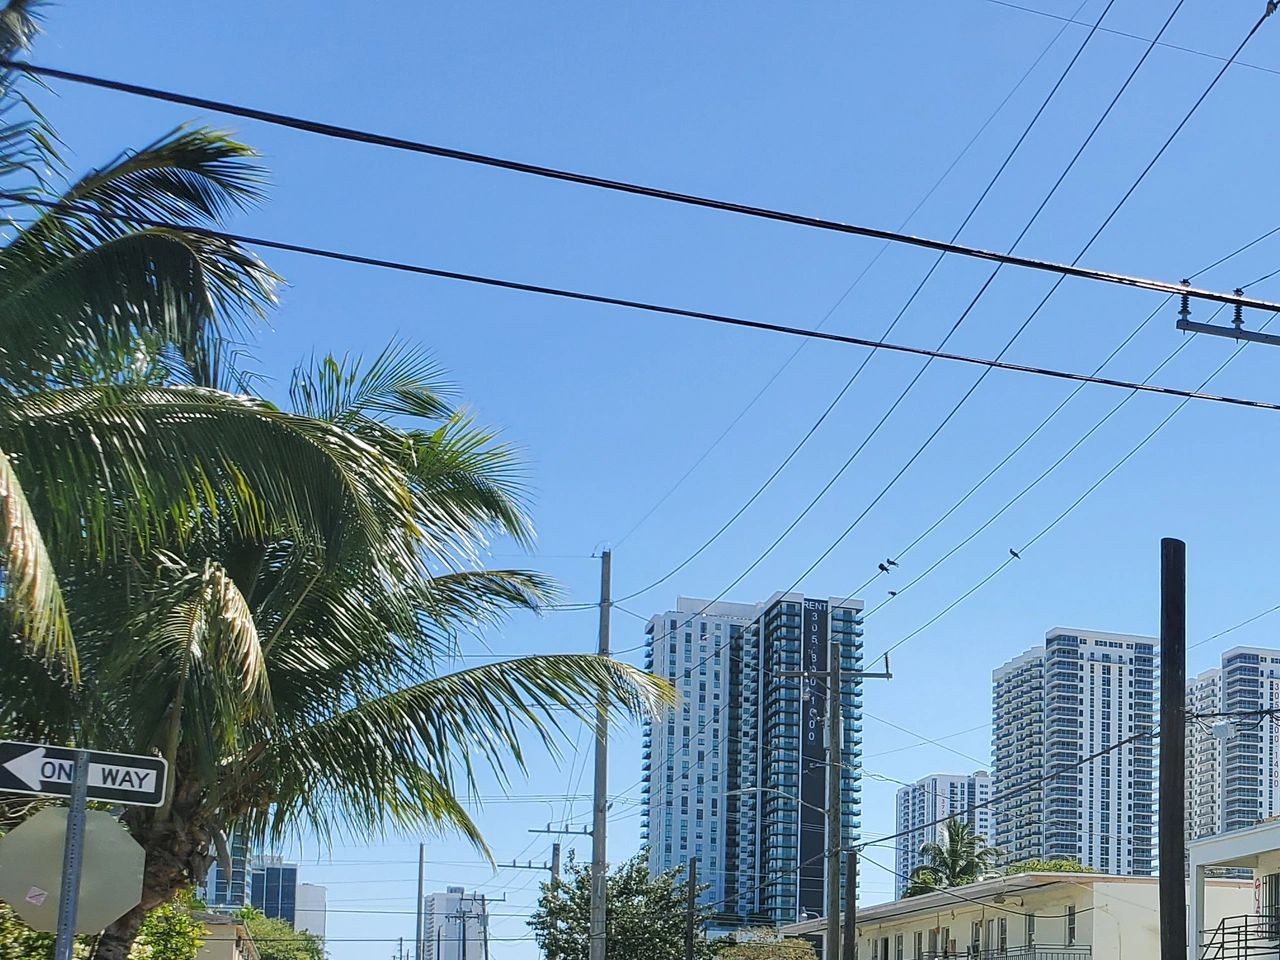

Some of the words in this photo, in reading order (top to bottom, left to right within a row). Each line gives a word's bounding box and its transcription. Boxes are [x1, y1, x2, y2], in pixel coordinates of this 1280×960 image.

[803, 601, 828, 611] RENT
[41, 761, 74, 781] ON
[101, 767, 150, 789] WAY
